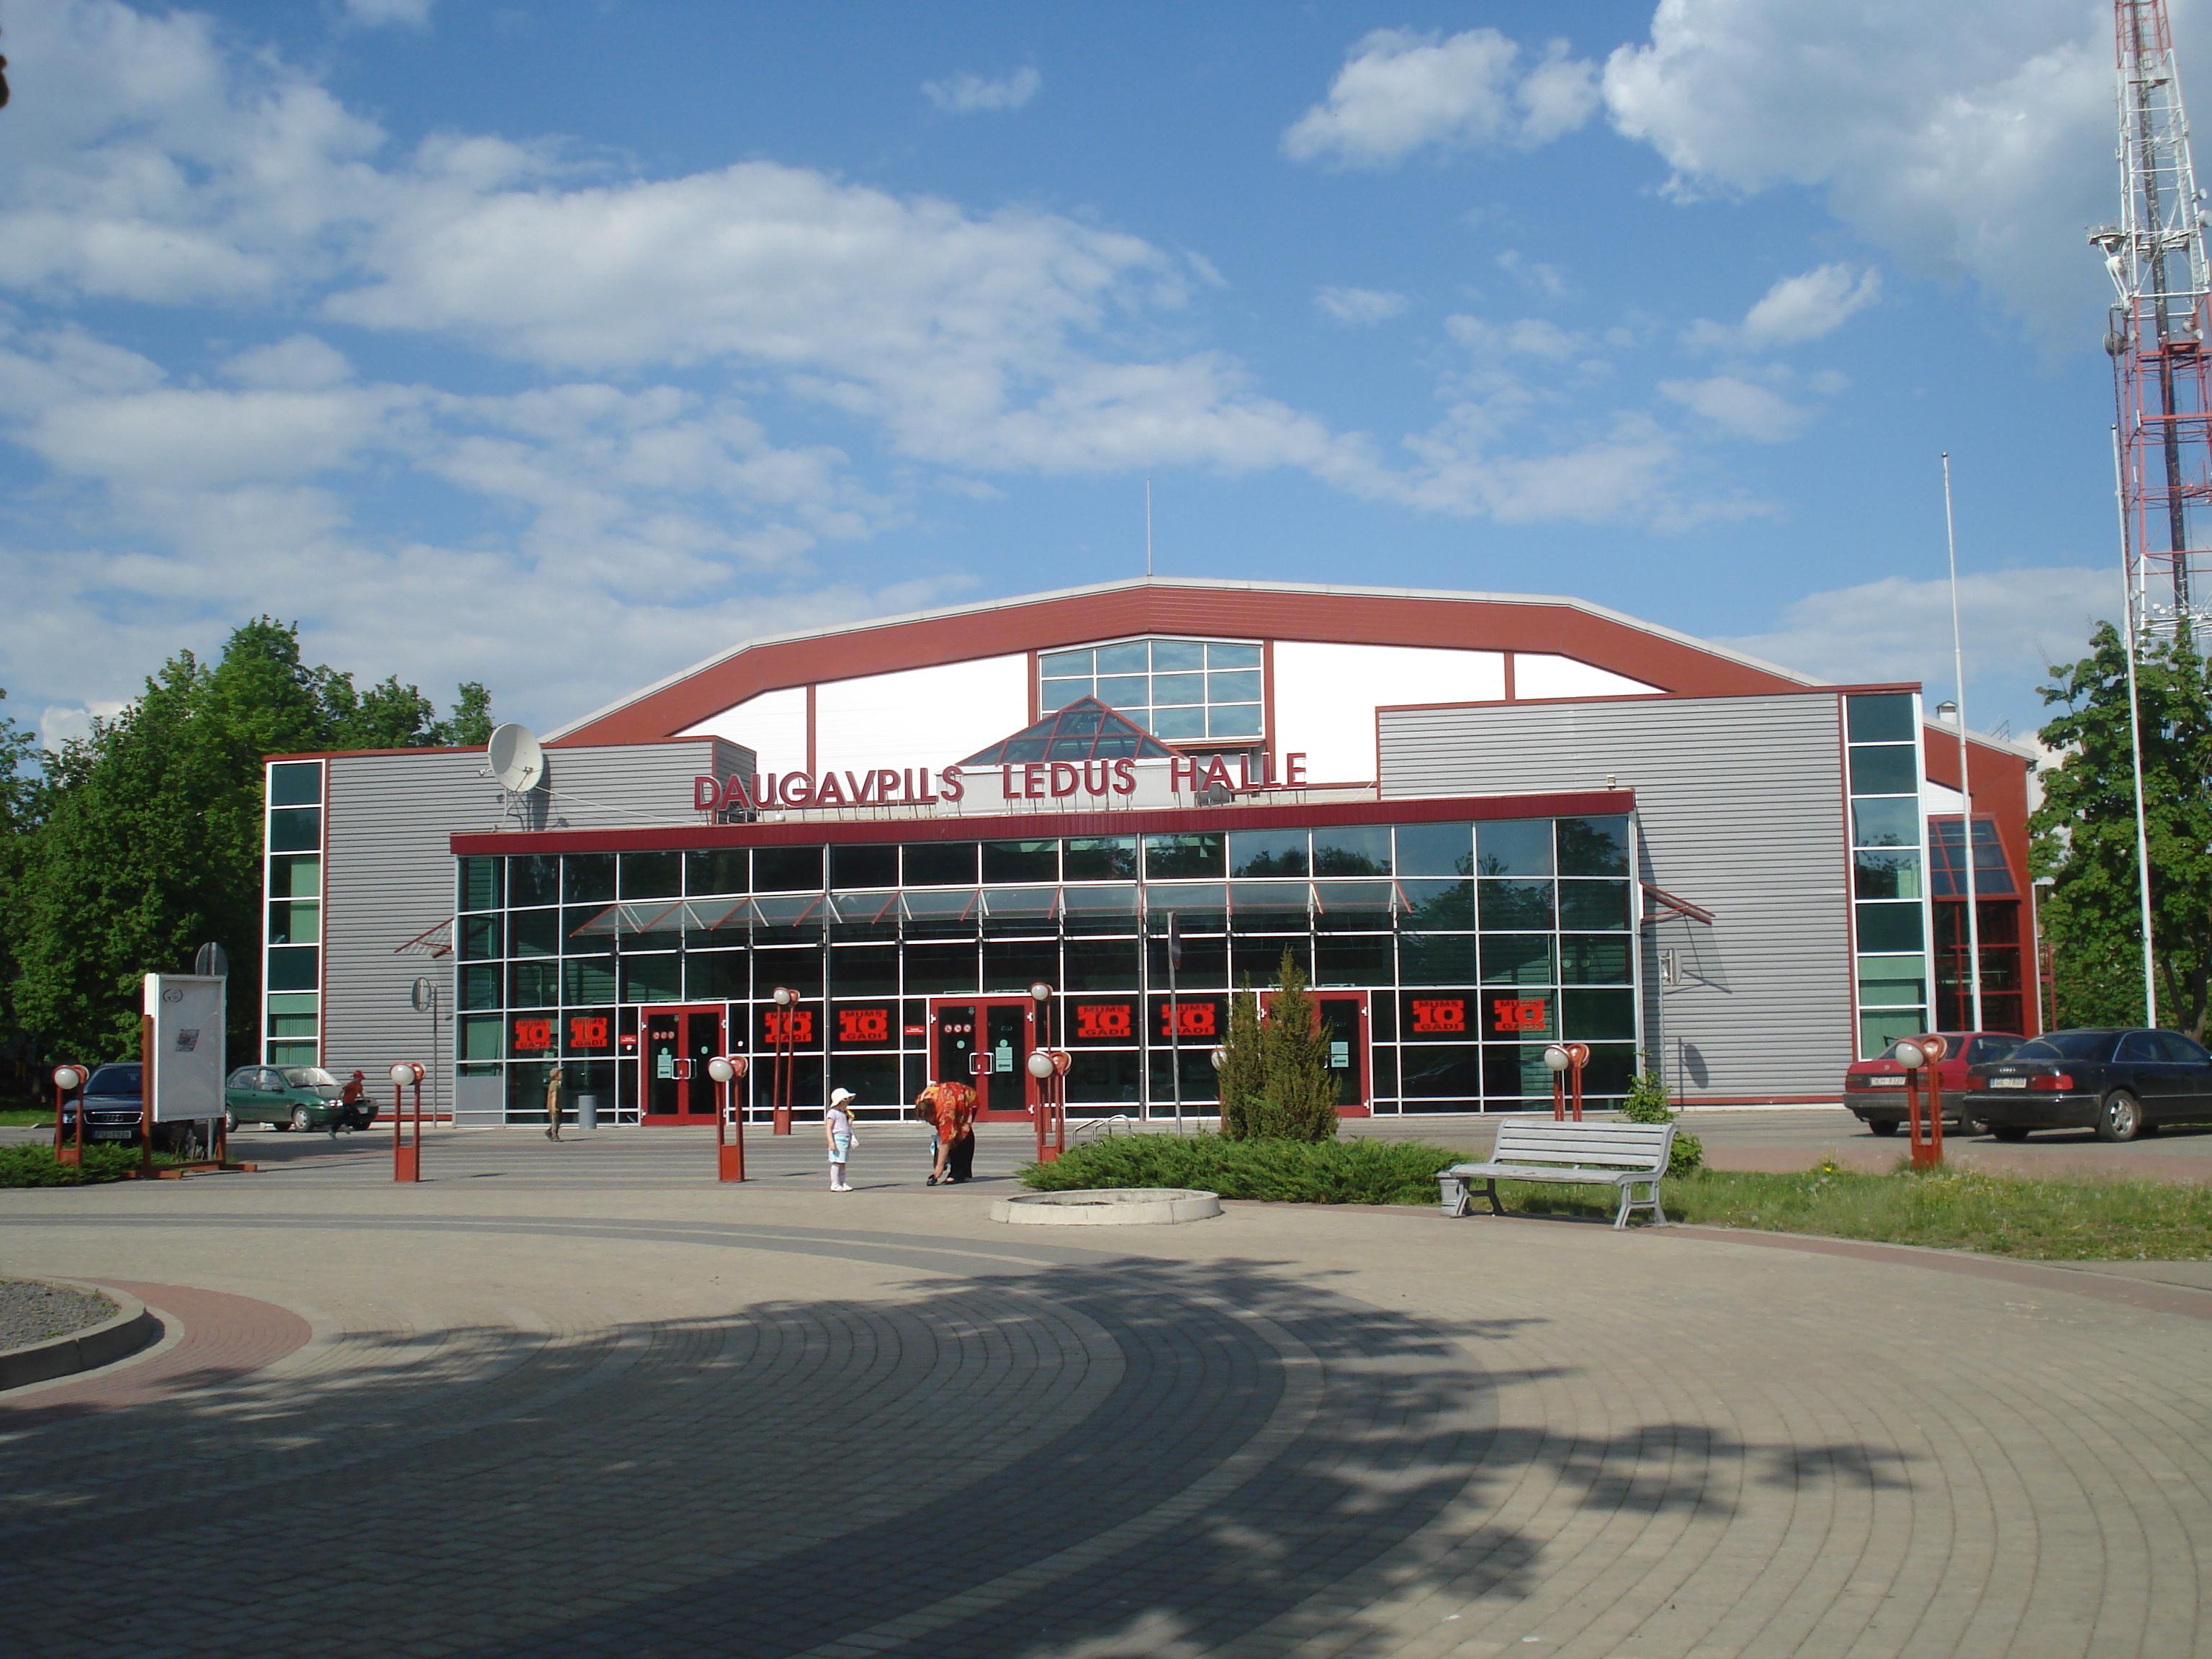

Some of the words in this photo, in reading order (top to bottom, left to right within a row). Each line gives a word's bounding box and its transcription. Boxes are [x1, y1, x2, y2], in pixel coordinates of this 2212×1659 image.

[694, 765, 965, 811] DAUGAVPILS
[1002, 757, 1136, 798] LEDUS
[1170, 752, 1307, 792] HALLE
[1078, 1012, 1130, 1029] 10
[1162, 1010, 1215, 1028] 10
[1413, 1007, 1464, 1023] 10
[1494, 1006, 1545, 1022] 10
[516, 1025, 551, 1041] 10
[570, 1024, 607, 1040] 10
[765, 1018, 811, 1035] 10
[840, 1016, 887, 1033] 10
